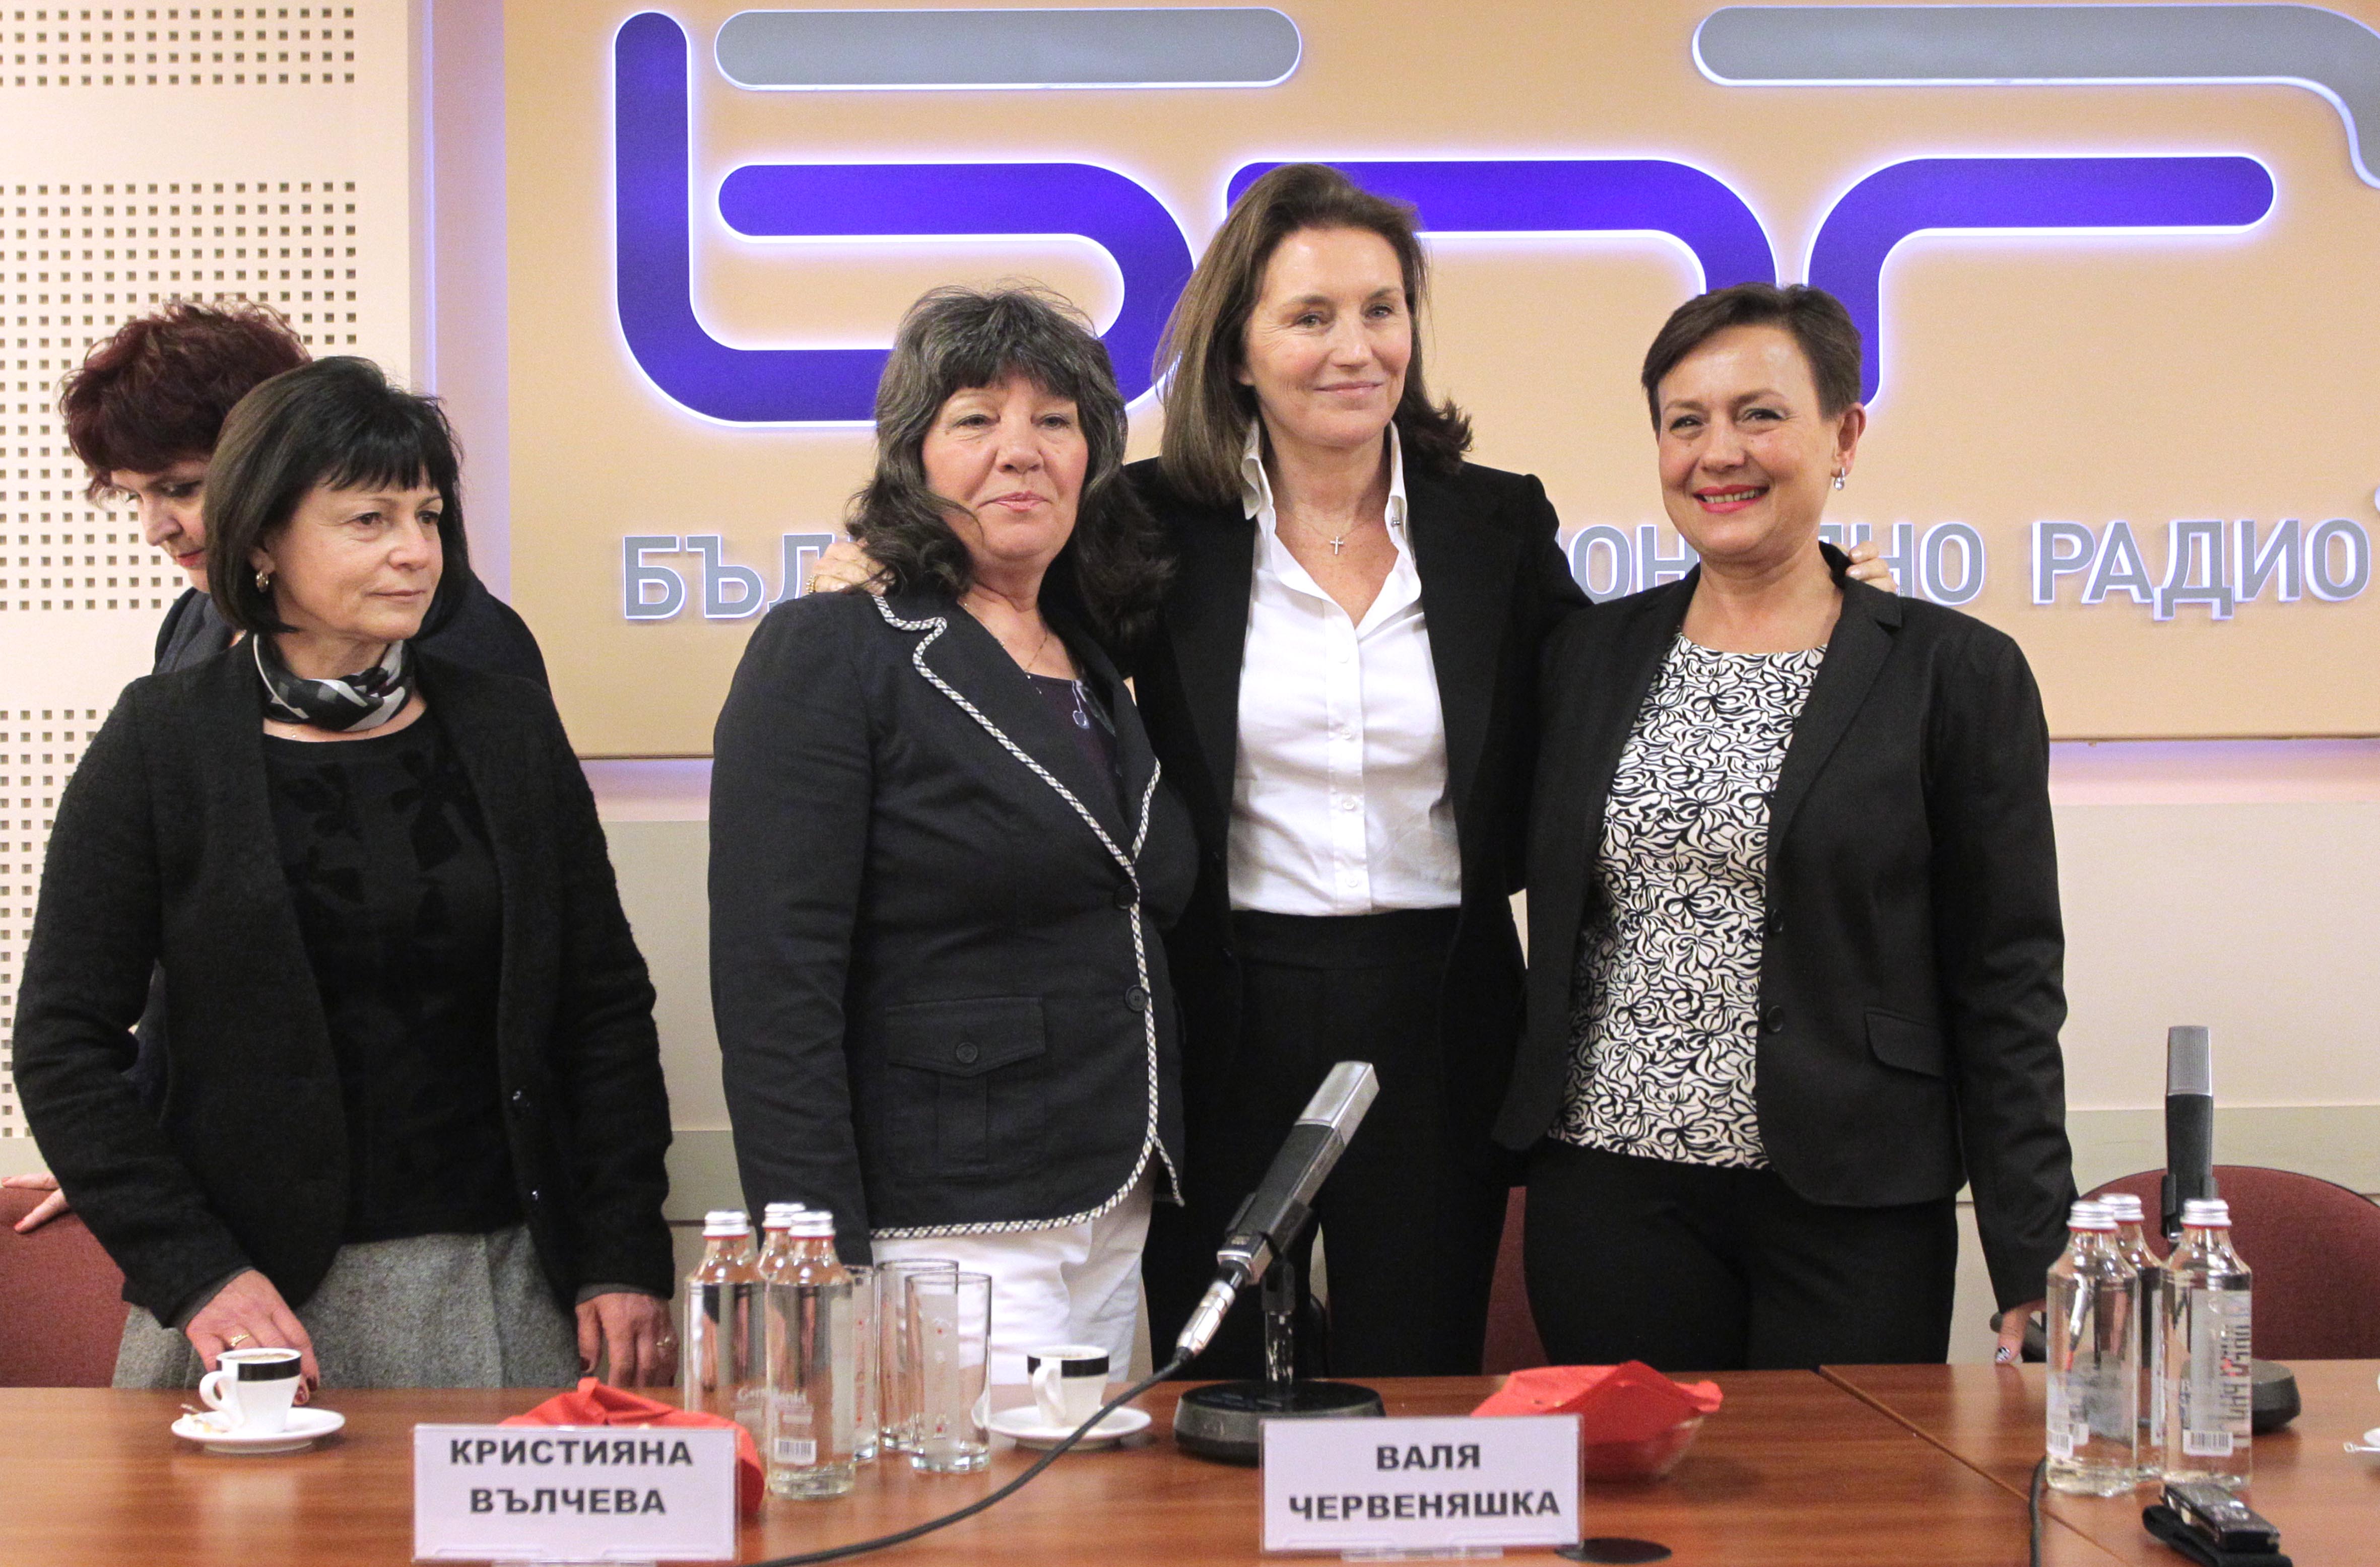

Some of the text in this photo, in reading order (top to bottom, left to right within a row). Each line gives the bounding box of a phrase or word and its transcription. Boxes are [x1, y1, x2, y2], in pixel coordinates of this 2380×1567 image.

[2032, 518, 2371, 621] РАДИО
[450, 1439, 693, 1466] КРИСТИЯНА
[1376, 1444, 1480, 1471] ВАЛЯ
[470, 1488, 666, 1515] ВЪЛЧЕВА
[1289, 1490, 1561, 1521] ЧЕРВЕНЯШКА
